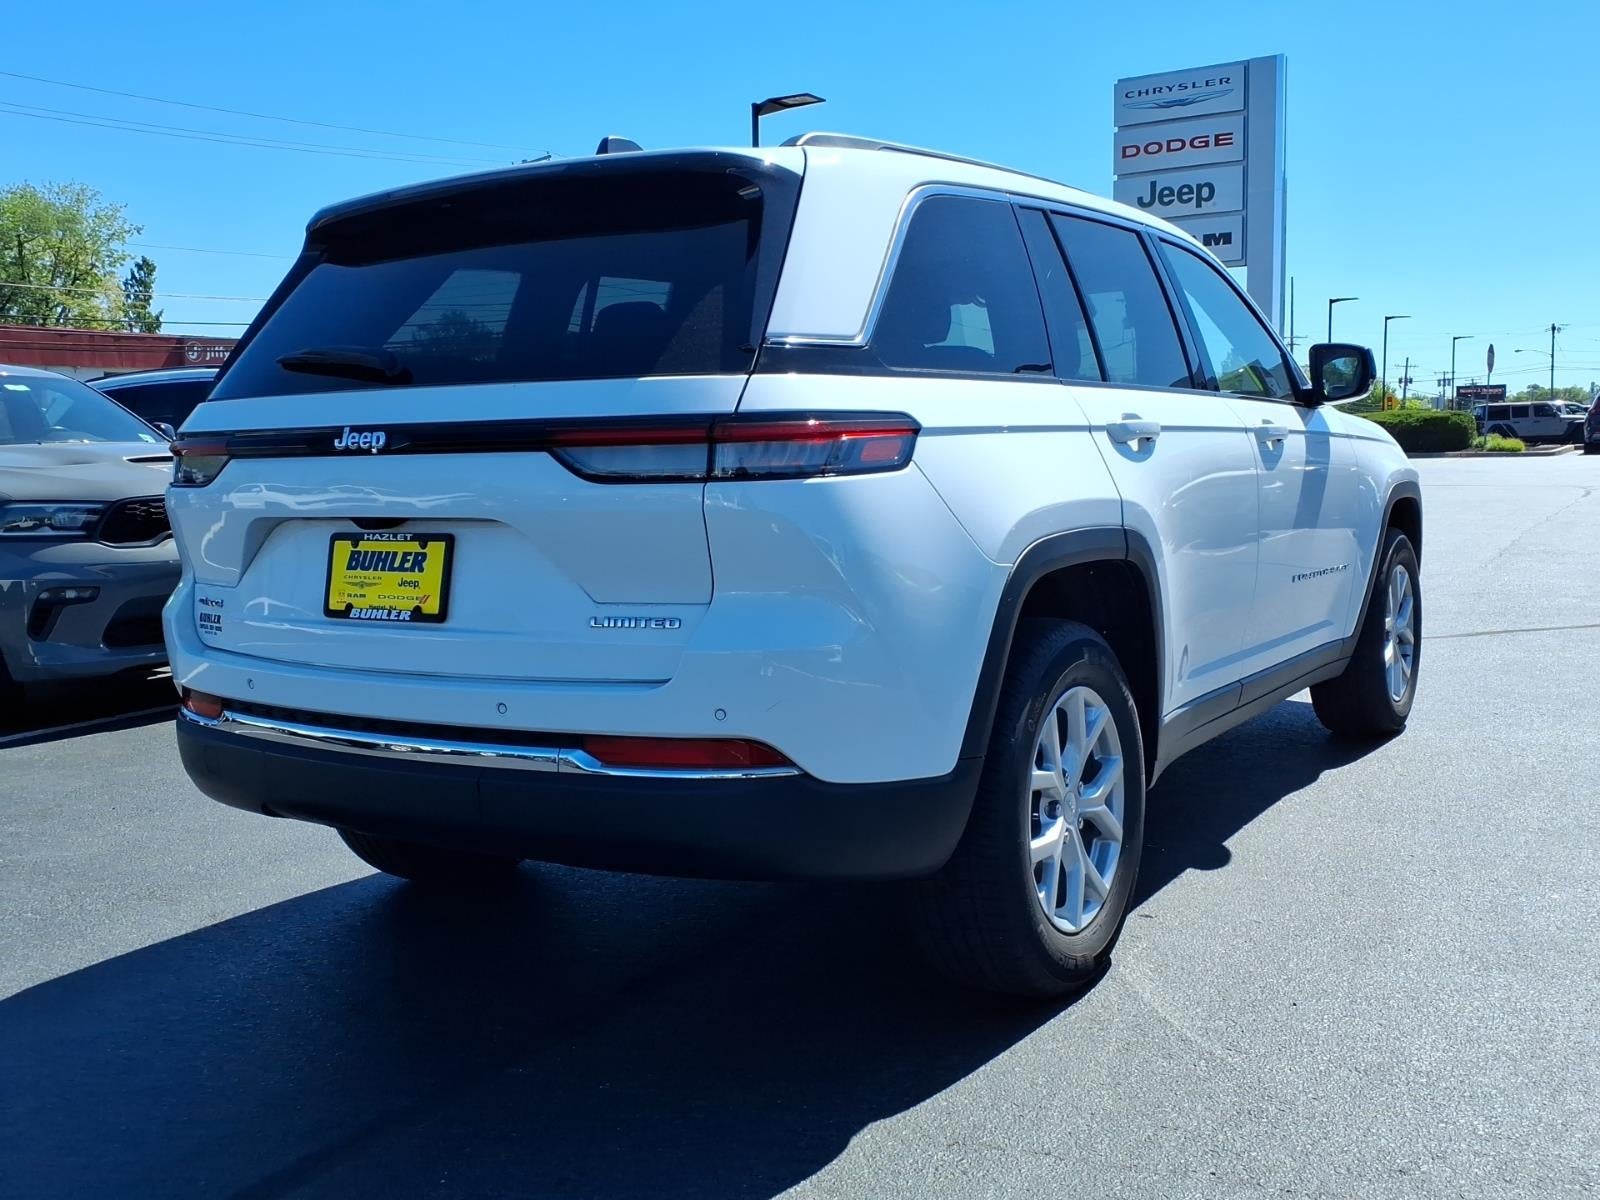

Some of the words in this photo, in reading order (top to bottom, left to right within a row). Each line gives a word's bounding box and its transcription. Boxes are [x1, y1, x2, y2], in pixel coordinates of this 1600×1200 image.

[1124, 76, 1232, 99] CHRYSLER
[1121, 132, 1234, 159] DODGE
[1136, 180, 1217, 208] Jeep
[334, 426, 386, 454] Jeep
[363, 533, 413, 541] HAZLET
[345, 549, 428, 573] BUHLER
[397, 577, 420, 590] Jeep
[349, 607, 412, 620] BUHLER
[590, 616, 681, 629] LIMITED
